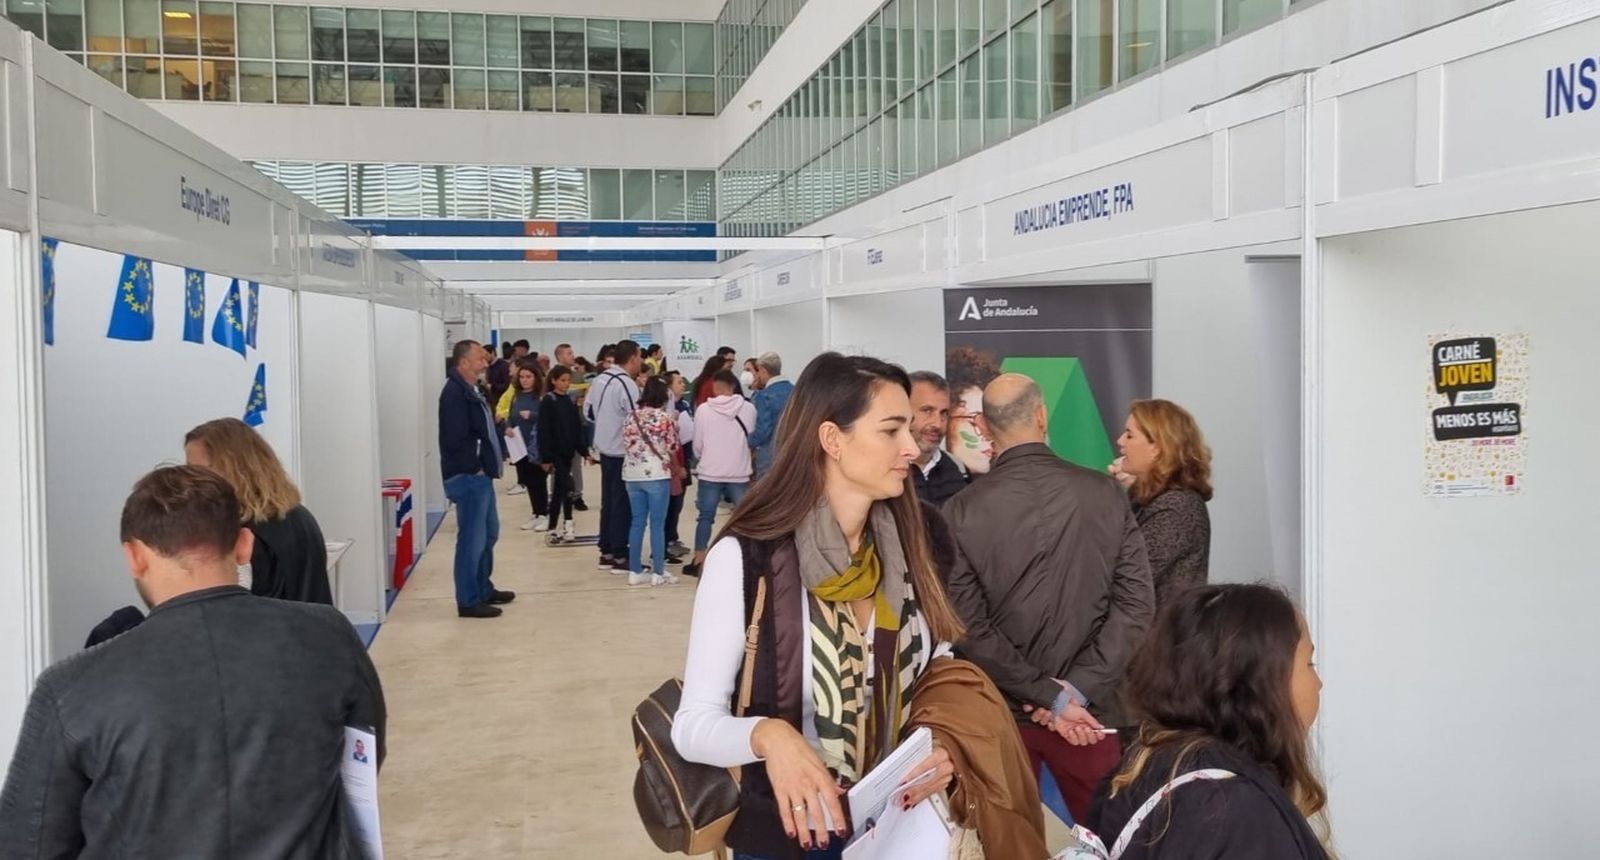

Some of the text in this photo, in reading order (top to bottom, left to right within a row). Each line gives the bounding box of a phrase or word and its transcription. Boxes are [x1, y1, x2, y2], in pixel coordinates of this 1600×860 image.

[1545, 57, 1600, 119] INS
[180, 176, 205, 224] Europe
[1059, 188, 1111, 226] EMPRENDE,
[1113, 182, 1134, 214] FPA
[983, 298, 1008, 307] Junta
[983, 305, 1038, 317] de Andalucía
[1438, 341, 1480, 361] CARNÉ
[1439, 362, 1493, 387] JOVEN
[1435, 408, 1518, 428] MENOS ES MÁS
